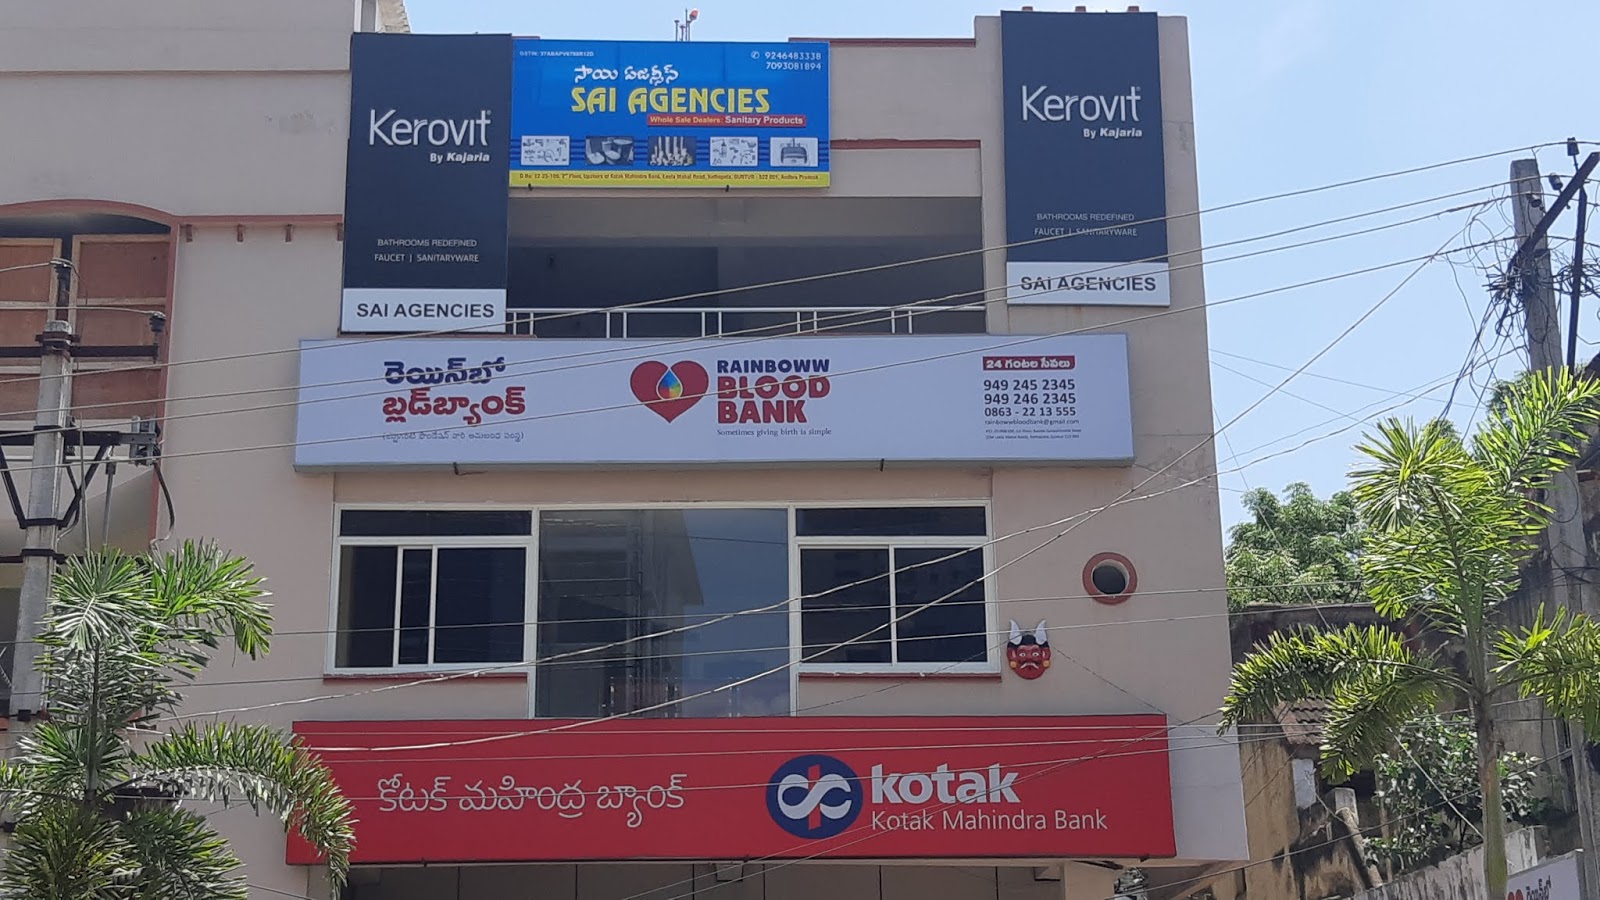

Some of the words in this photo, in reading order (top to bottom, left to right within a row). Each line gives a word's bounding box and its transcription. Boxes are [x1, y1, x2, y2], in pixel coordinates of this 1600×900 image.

[764, 51, 822, 61] 9246483338
[765, 61, 822, 71] 7093081894
[574, 64, 619, 84] సాయి
[571, 86, 617, 115] SAI
[627, 87, 771, 115] AGENCIES
[1021, 84, 1142, 122] Kerovit
[368, 108, 492, 147] Kerovit
[649, 115, 674, 125] Whole
[675, 115, 692, 125] Sale
[724, 115, 761, 127] Sanitary
[763, 116, 804, 126] Products
[1083, 127, 1097, 140] By
[1099, 127, 1143, 139] Kajaria
[429, 152, 444, 165] By
[446, 152, 491, 164] Kajaria
[1036, 213, 1088, 222] BATHROOMS
[1089, 213, 1135, 222] REDEFINED
[1034, 227, 1065, 237] FAUCET
[377, 238, 430, 248] BATHROOMS
[431, 238, 478, 248] REDEFINED
[374, 253, 406, 263] FAUCET
[416, 253, 480, 263] SANITARYWARE
[1020, 275, 1051, 292] SAI
[1056, 275, 1157, 292] AGENCIES
[356, 303, 389, 318] SAI
[393, 303, 496, 319] AGENCIES
[717, 359, 830, 374] RAINBOWW
[986, 359, 1003, 369] 24
[717, 374, 831, 400] BLOOD
[983, 379, 1009, 391] 949
[1012, 379, 1038, 391] 245
[1042, 378, 1076, 391] 2345
[984, 393, 1010, 405] 949
[1013, 393, 1039, 405] 246
[1042, 392, 1077, 405] 2345
[717, 400, 808, 424] BANK
[984, 407, 1012, 417] 0863
[1022, 407, 1036, 417] 22
[1039, 407, 1053, 417] 13
[1056, 406, 1077, 417] 555
[716, 428, 755, 437] Sometimes
[756, 428, 779, 438] giving
[780, 428, 798, 436] birth
[800, 428, 807, 436] is
[808, 427, 832, 438] simple
[870, 762, 1022, 805] kotak
[376, 772, 452, 813] కోటక్
[595, 773, 688, 829] బ్యాంక్
[871, 809, 936, 831] Kotak
[943, 809, 1047, 831] Mahindra
[1054, 809, 1109, 831] Bank
